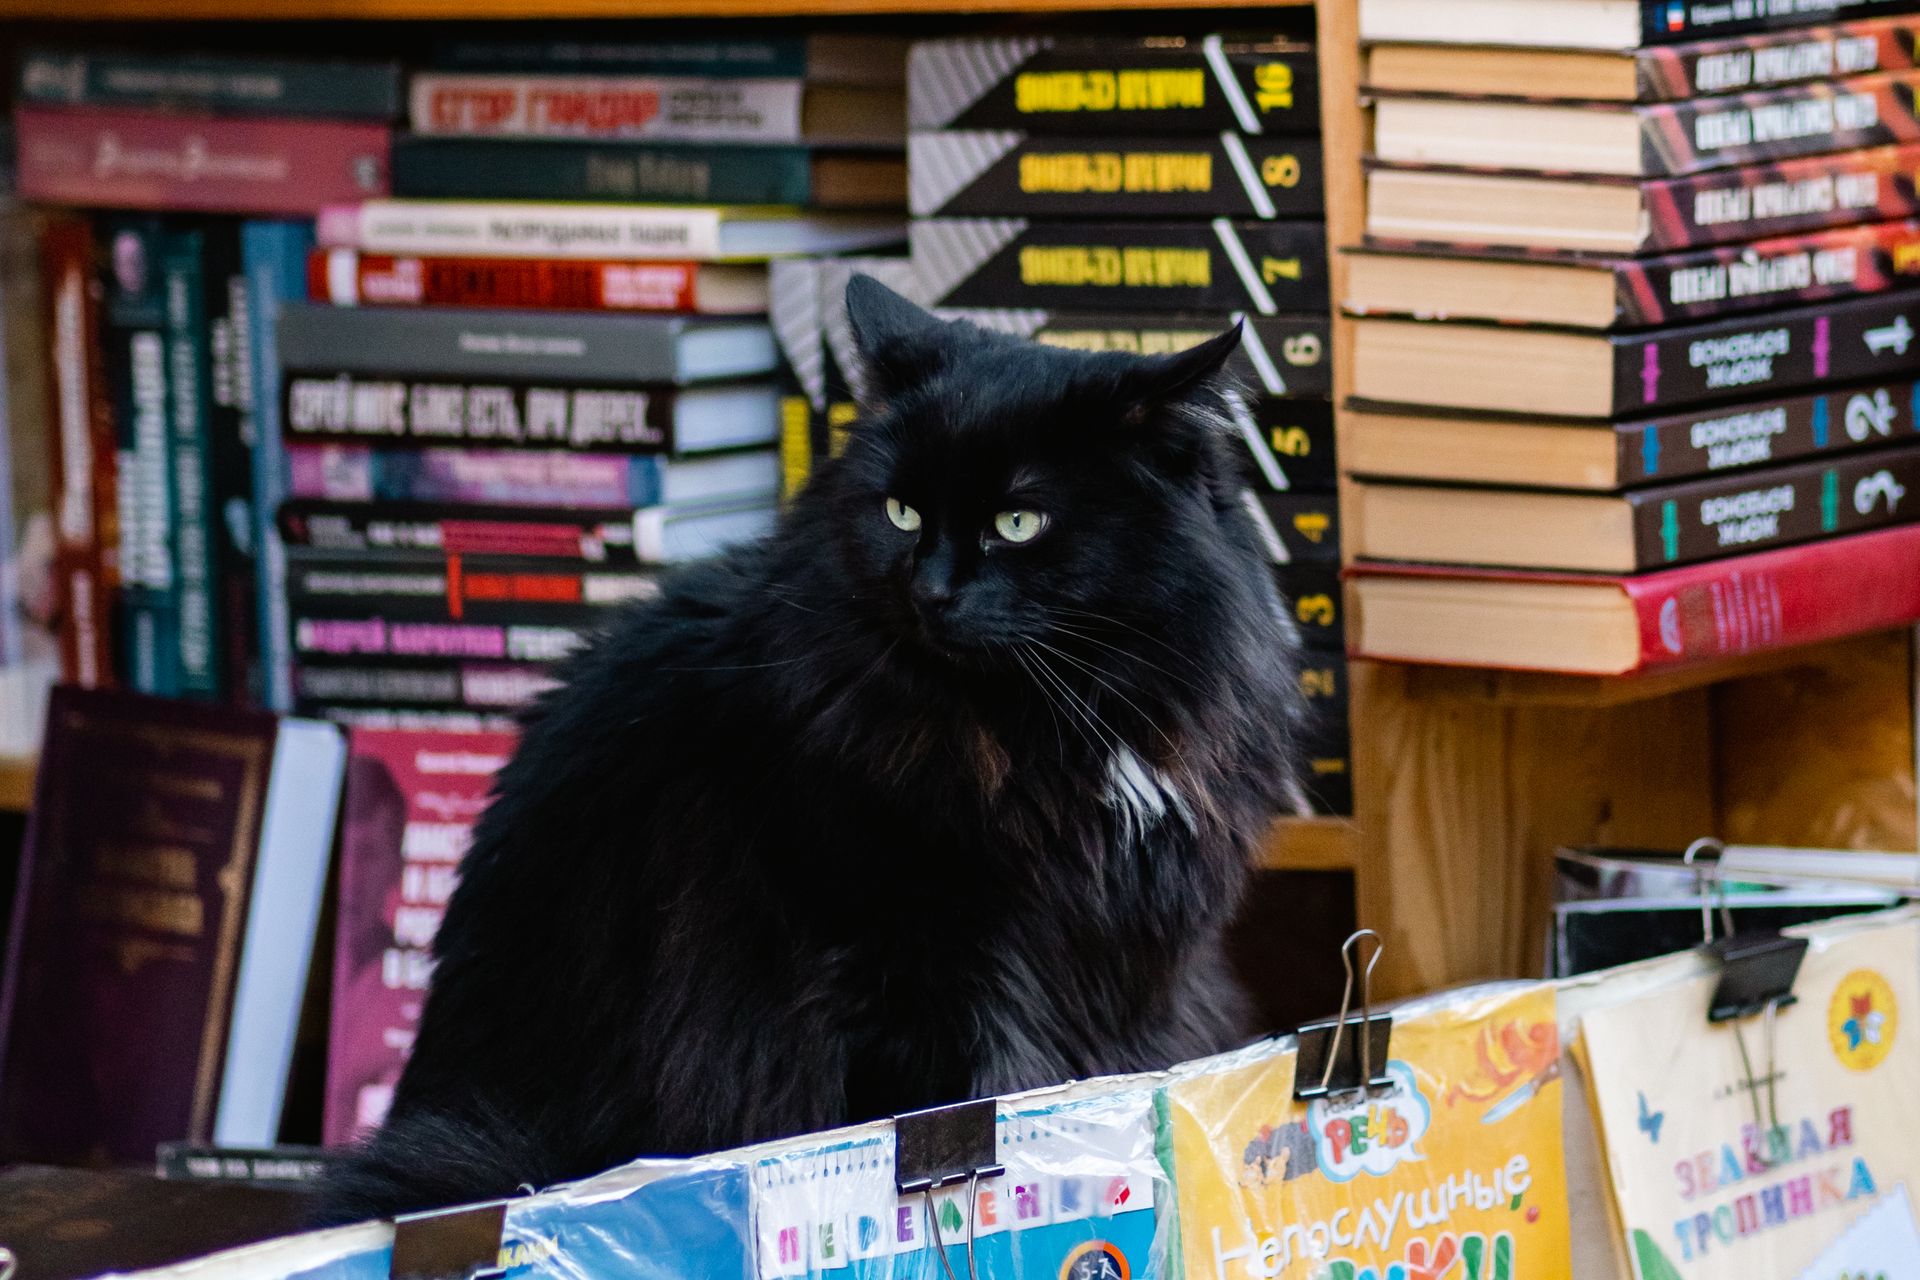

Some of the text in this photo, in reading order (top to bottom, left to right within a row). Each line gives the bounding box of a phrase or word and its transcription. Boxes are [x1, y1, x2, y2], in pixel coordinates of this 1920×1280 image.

[1696, 52, 1750, 91] ГРЕХОВ
[1753, 41, 1833, 83] СМЕРТНЫХ
[1255, 63, 1294, 114] 10
[1695, 110, 1750, 150] ГРЕХОВ
[1753, 99, 1833, 142] СМЕРТНЫХ
[1262, 154, 1300, 188] 8
[1695, 187, 1749, 226] ГРЕХОВ
[1752, 176, 1833, 219] СМЕРТНЫХ
[1262, 257, 1301, 286] 7
[1670, 265, 1727, 304] ГРЕХОВ
[1728, 253, 1811, 298] СМЕРТНЫХ
[1283, 333, 1323, 366] 6
[1863, 315, 1914, 356] 1
[1844, 388, 1897, 442] 2
[1271, 426, 1311, 457] 5
[1854, 470, 1906, 515] 3
[1293, 512, 1330, 544] 4
[1296, 594, 1335, 627] 3
[1325, 1103, 1409, 1165] РЕЧЬ
[1211, 1154, 1532, 1280] Непослушные
[1674, 1156, 1877, 1263] ТРОПИНКА
[1081, 1257, 1109, 1280] 5-7
